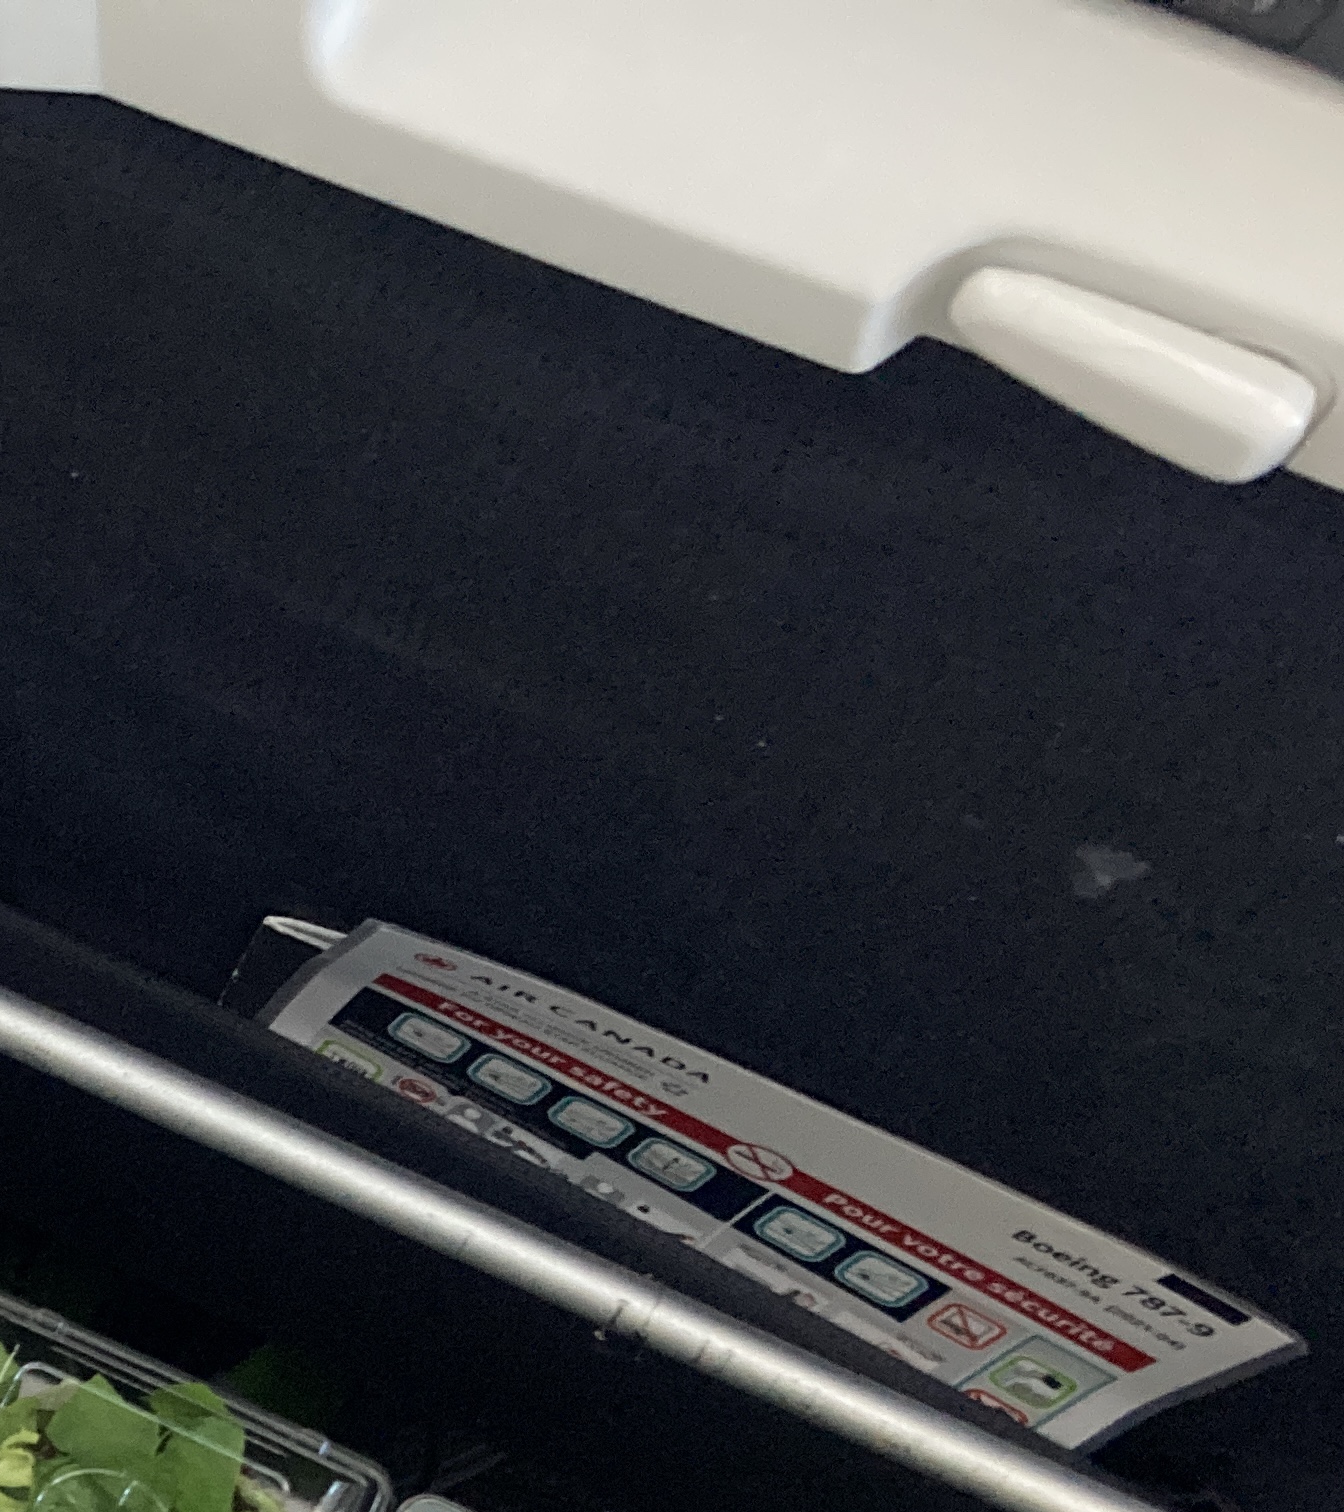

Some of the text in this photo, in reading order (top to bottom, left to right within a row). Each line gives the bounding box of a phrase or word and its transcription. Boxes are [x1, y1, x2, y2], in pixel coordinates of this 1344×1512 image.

[438, 1000, 667, 1117] For your safety
[471, 975, 537, 1004] AIR
[550, 1004, 710, 1084] CANADA
[825, 1193, 1116, 1353] Pour votre sécurité
[1012, 1229, 1215, 1338] Boeing 787-9
